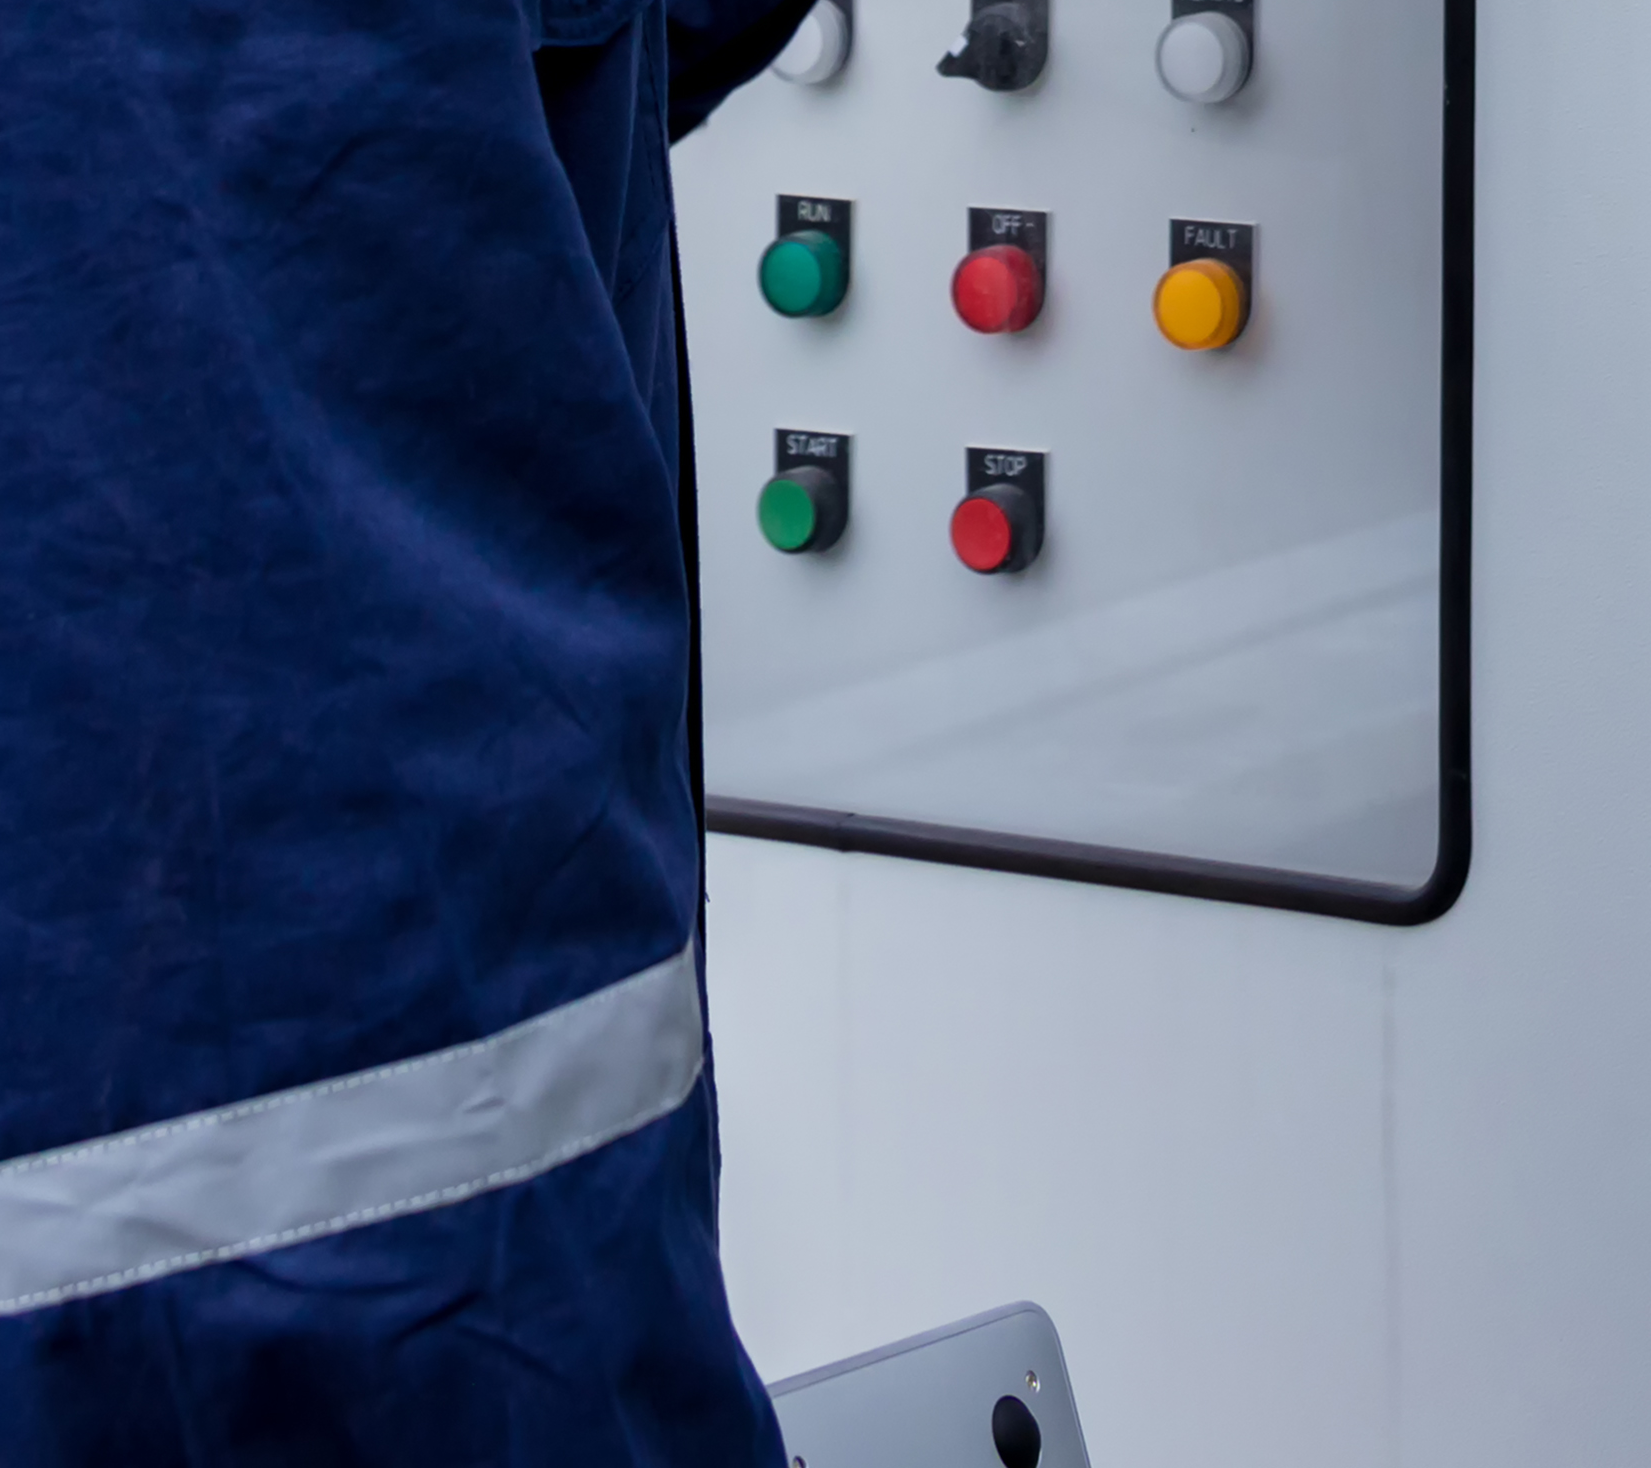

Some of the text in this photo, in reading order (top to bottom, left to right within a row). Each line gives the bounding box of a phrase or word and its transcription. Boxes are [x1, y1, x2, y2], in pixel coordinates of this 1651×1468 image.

[798, 199, 831, 222] RUN
[1184, 225, 1238, 250] FAULT
[786, 433, 838, 456] START
[984, 454, 1027, 477] STOP
